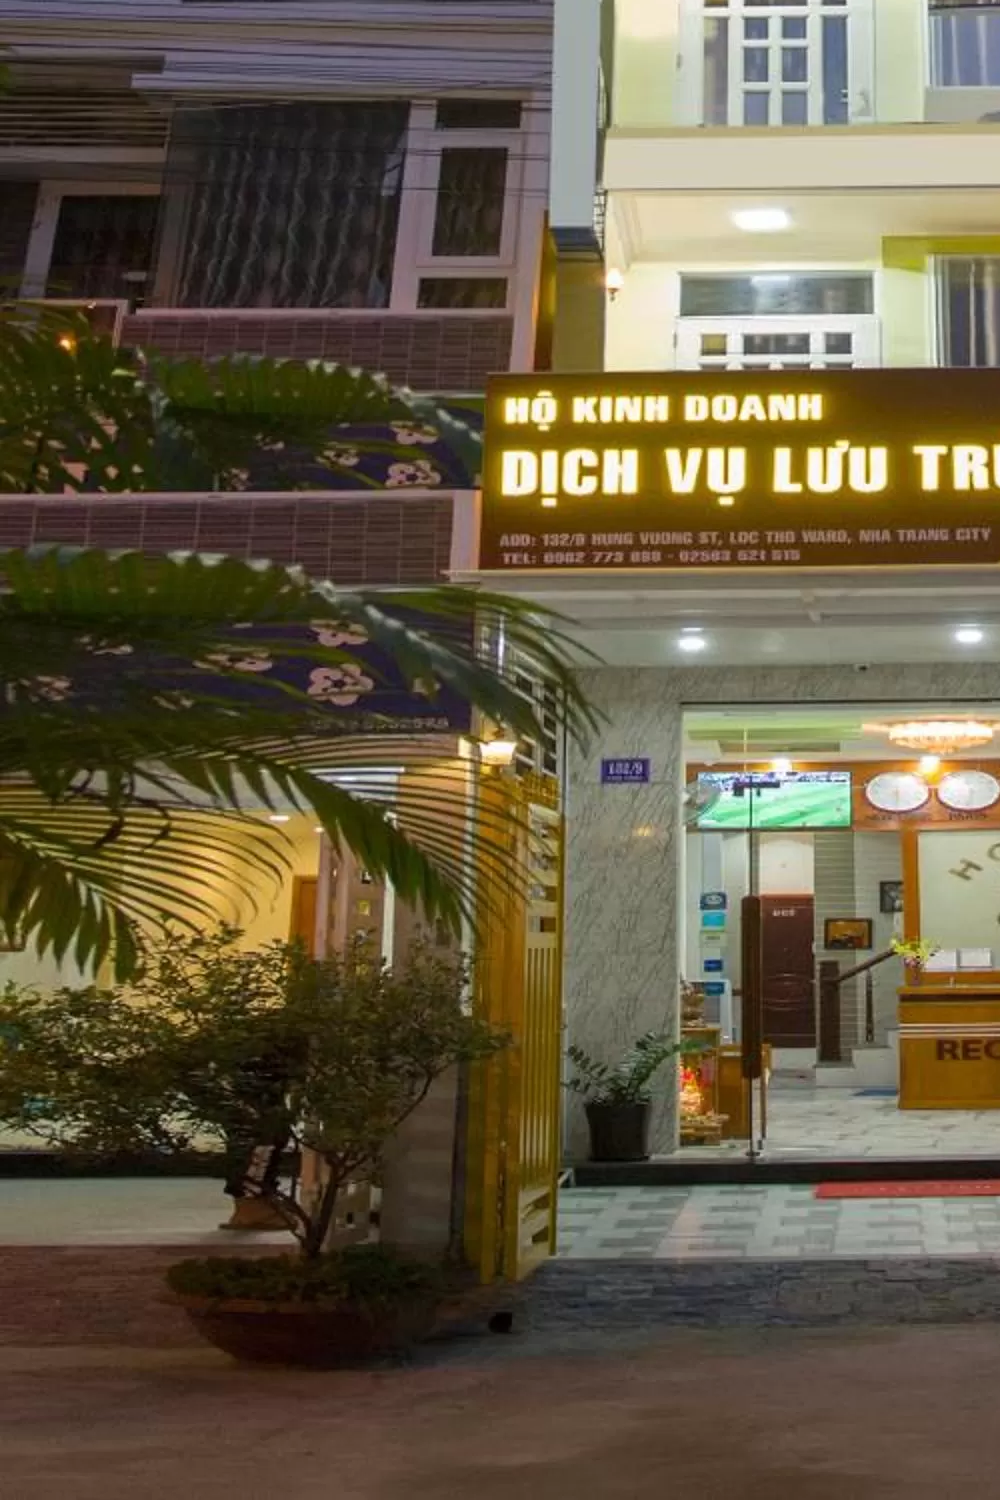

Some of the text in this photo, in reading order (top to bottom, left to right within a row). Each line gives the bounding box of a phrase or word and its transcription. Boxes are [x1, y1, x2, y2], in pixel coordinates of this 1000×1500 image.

[504, 391, 823, 431] HỘ KINH DOANH
[501, 448, 639, 507] DỊCH
[664, 447, 747, 506] VỤ
[773, 440, 888, 493] LƯU
[859, 529, 891, 543] NHA
[896, 528, 949, 542] TRANG
[955, 527, 991, 541] CITY
[503, 551, 536, 565] TEL:
